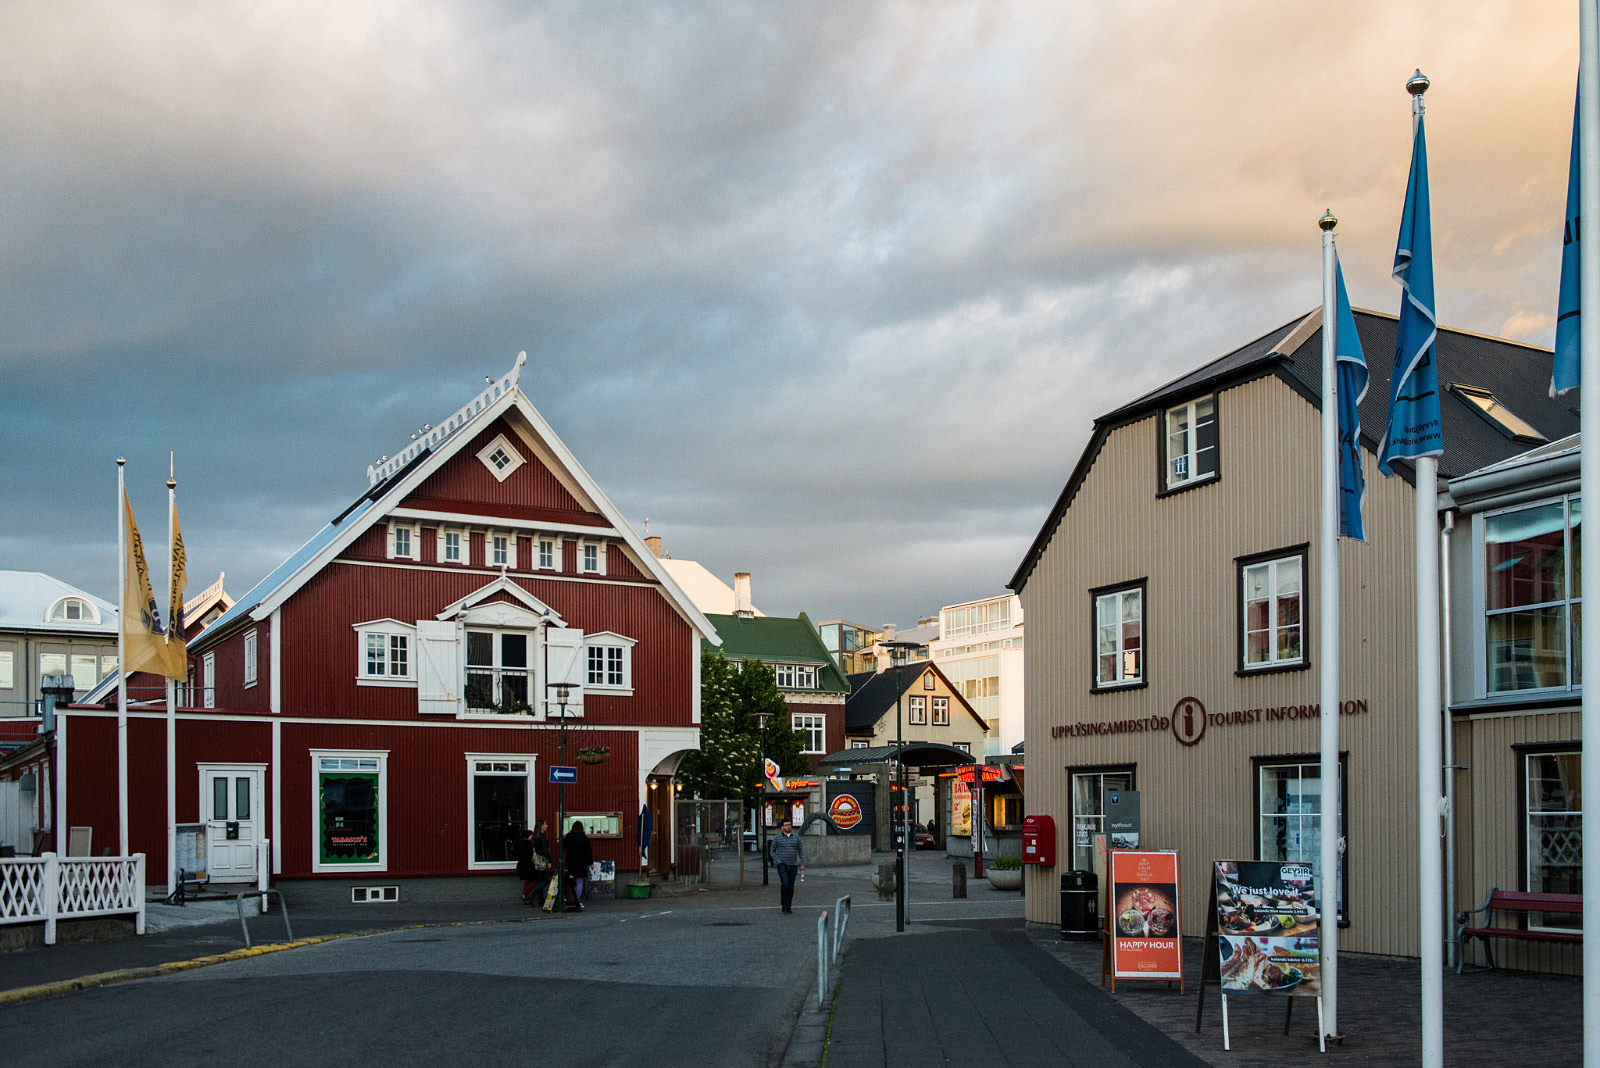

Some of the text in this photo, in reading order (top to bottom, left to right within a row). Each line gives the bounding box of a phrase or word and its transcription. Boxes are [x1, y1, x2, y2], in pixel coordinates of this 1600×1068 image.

[1051, 715, 1170, 739] UPPLÝSINGAMIÐSTÖÐ
[1208, 708, 1262, 726] TOURIST
[1265, 699, 1368, 721] INFORMION
[1232, 886, 1303, 896] We just love it.
[1119, 941, 1174, 949] HAPPY HOUR
